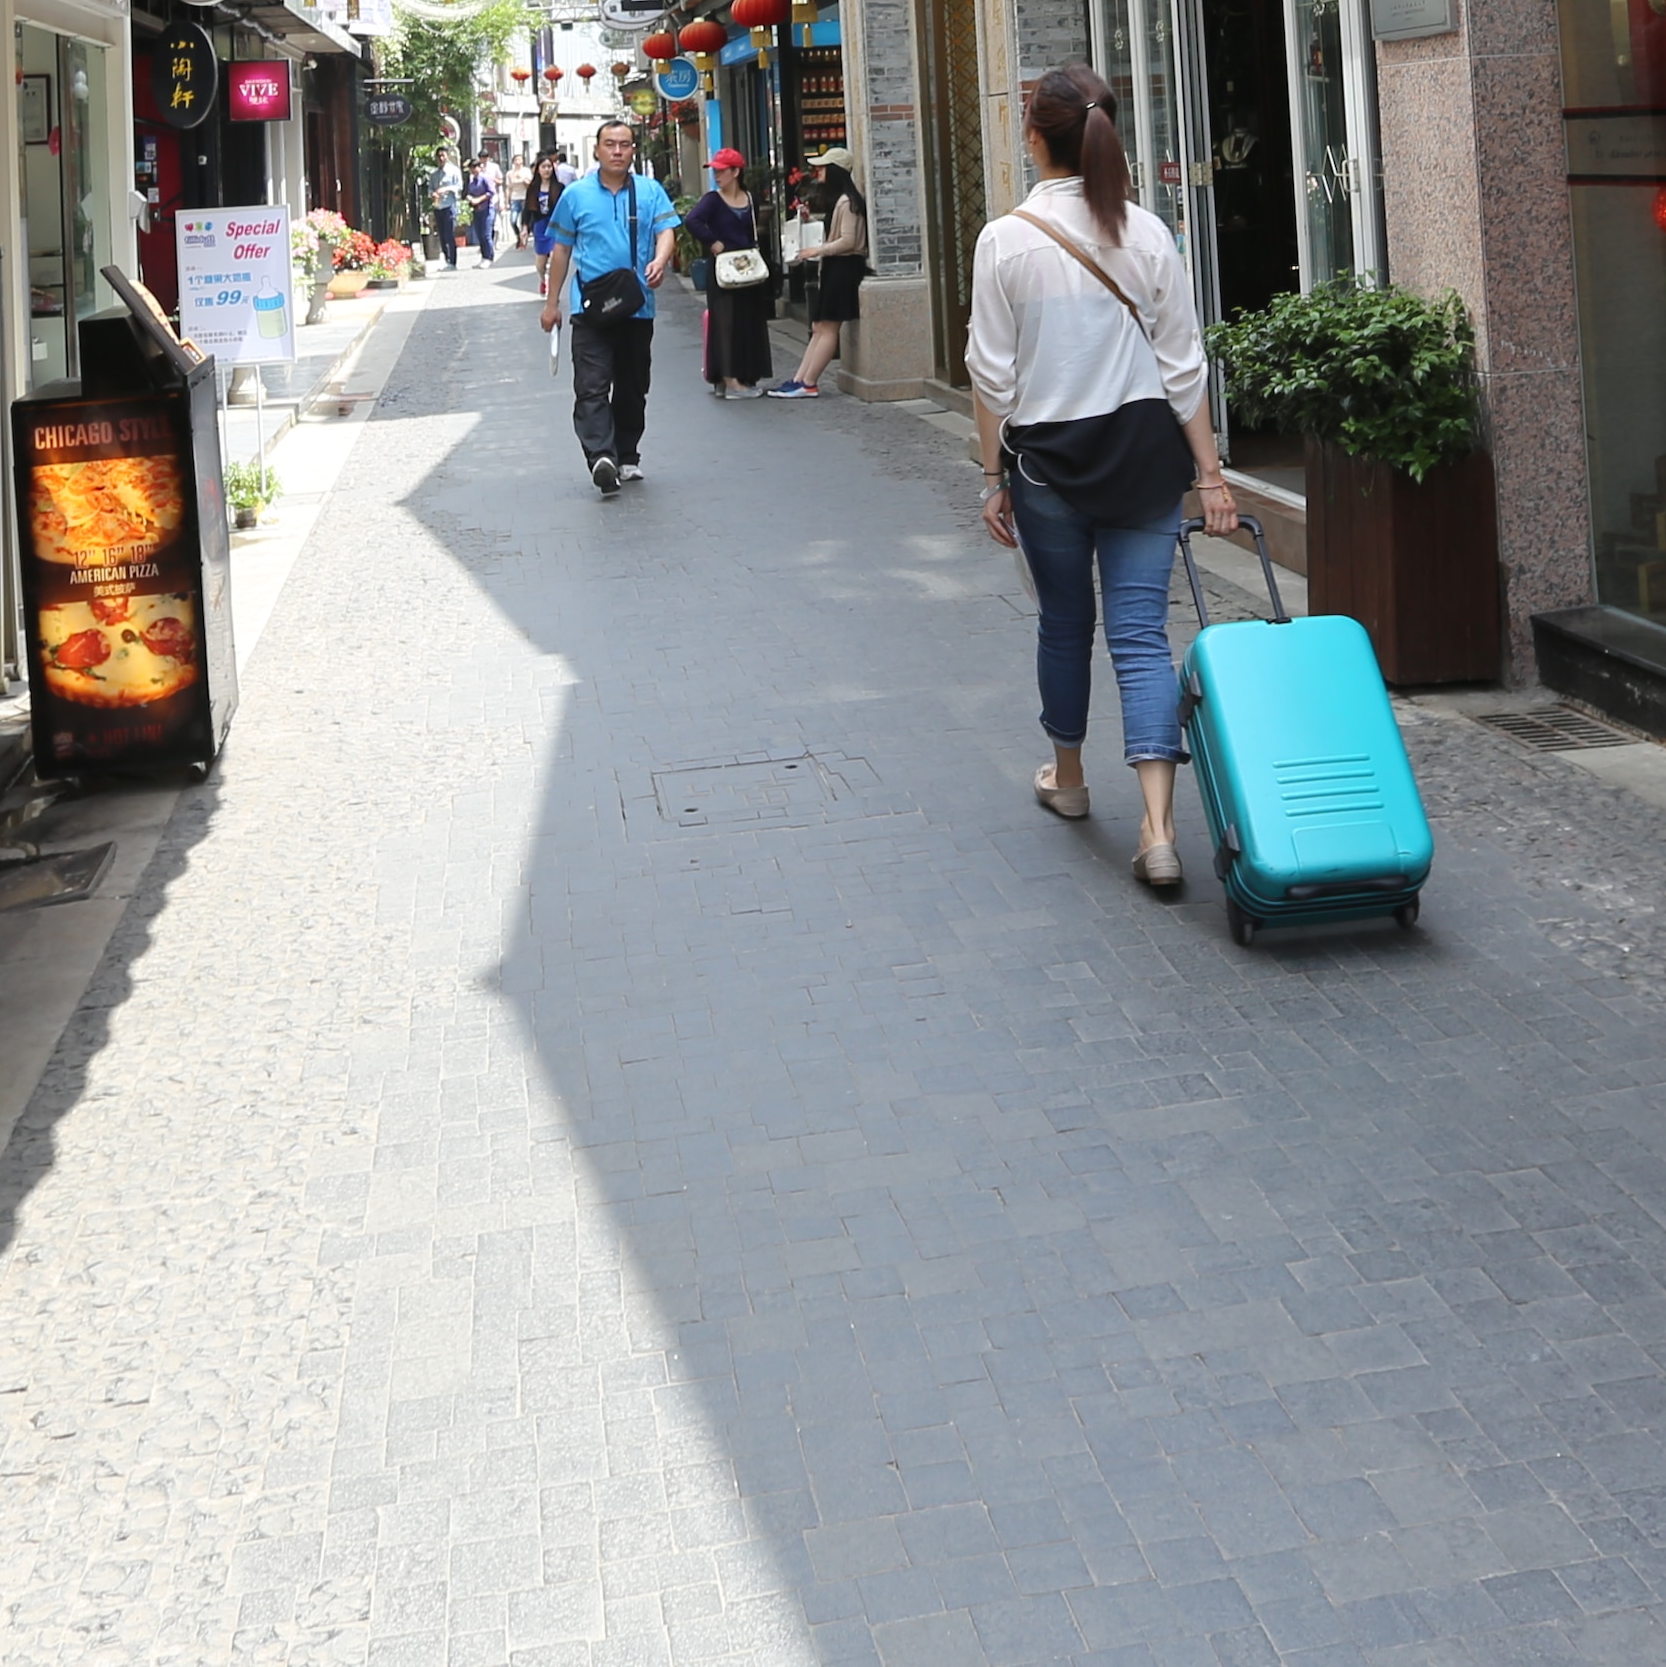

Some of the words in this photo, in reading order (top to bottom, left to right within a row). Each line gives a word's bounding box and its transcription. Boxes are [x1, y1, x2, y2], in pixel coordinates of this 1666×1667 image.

[238, 82, 279, 97] VIVE
[225, 219, 282, 240] Special
[233, 244, 271, 261] Offer
[34, 421, 113, 450] CHICAGO
[69, 566, 127, 585] AMERICAN
[129, 563, 160, 579] PIZZA
